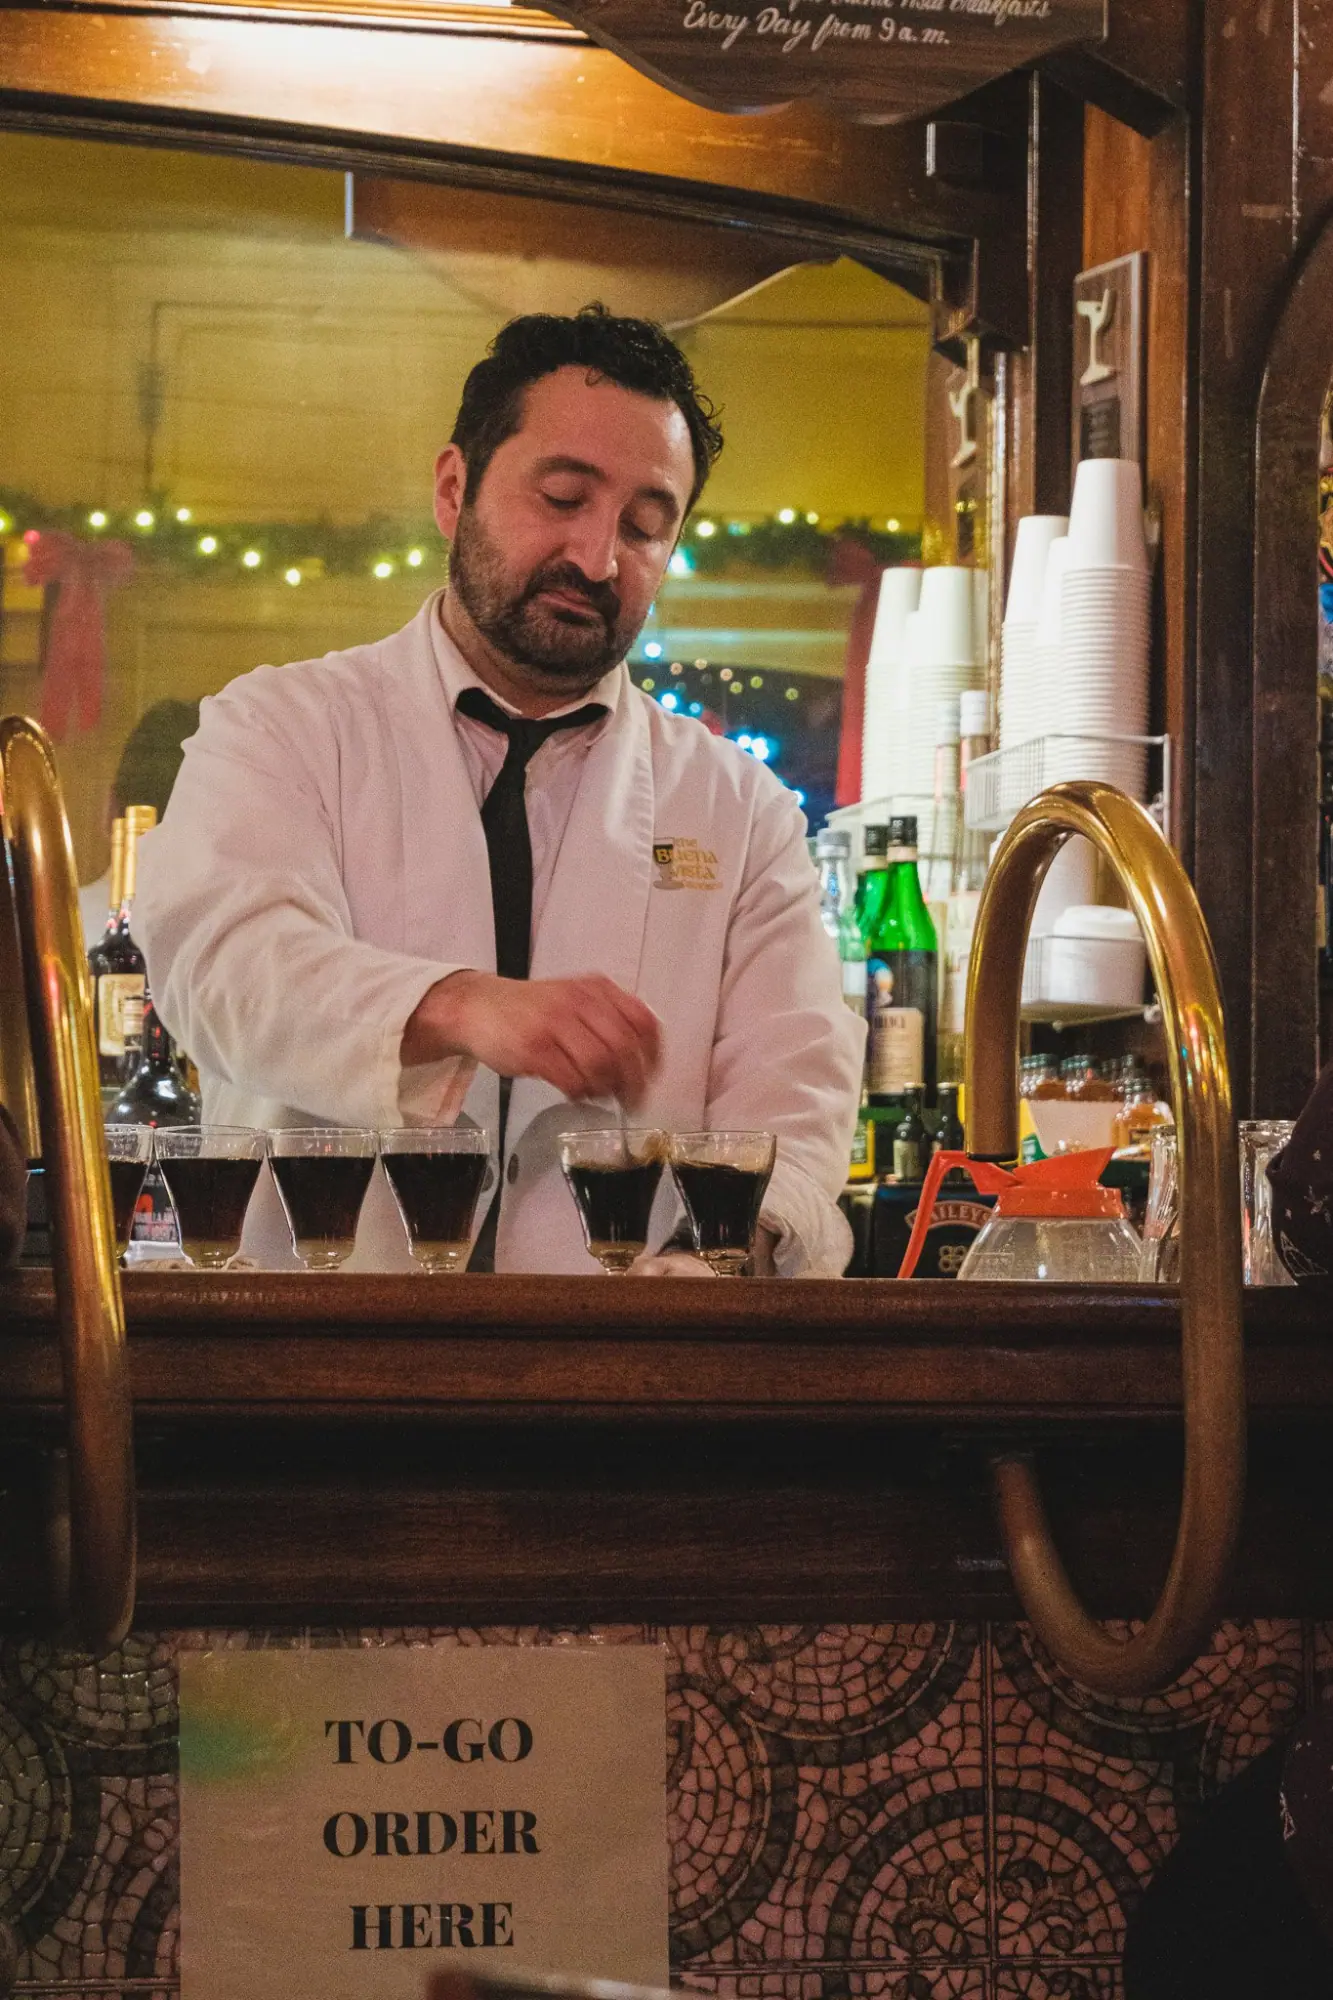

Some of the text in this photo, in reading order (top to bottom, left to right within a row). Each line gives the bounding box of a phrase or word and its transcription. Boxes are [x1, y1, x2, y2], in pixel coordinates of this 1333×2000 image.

[683, 1, 749, 49] Every
[756, 7, 811, 53] Day
[811, 14, 873, 51] from
[878, 17, 897, 42] 9
[914, 1203, 990, 1225] AILEYS
[324, 1718, 533, 1765] TO-GO
[323, 1810, 541, 1858] ORDER
[349, 1902, 514, 1950] HERE
